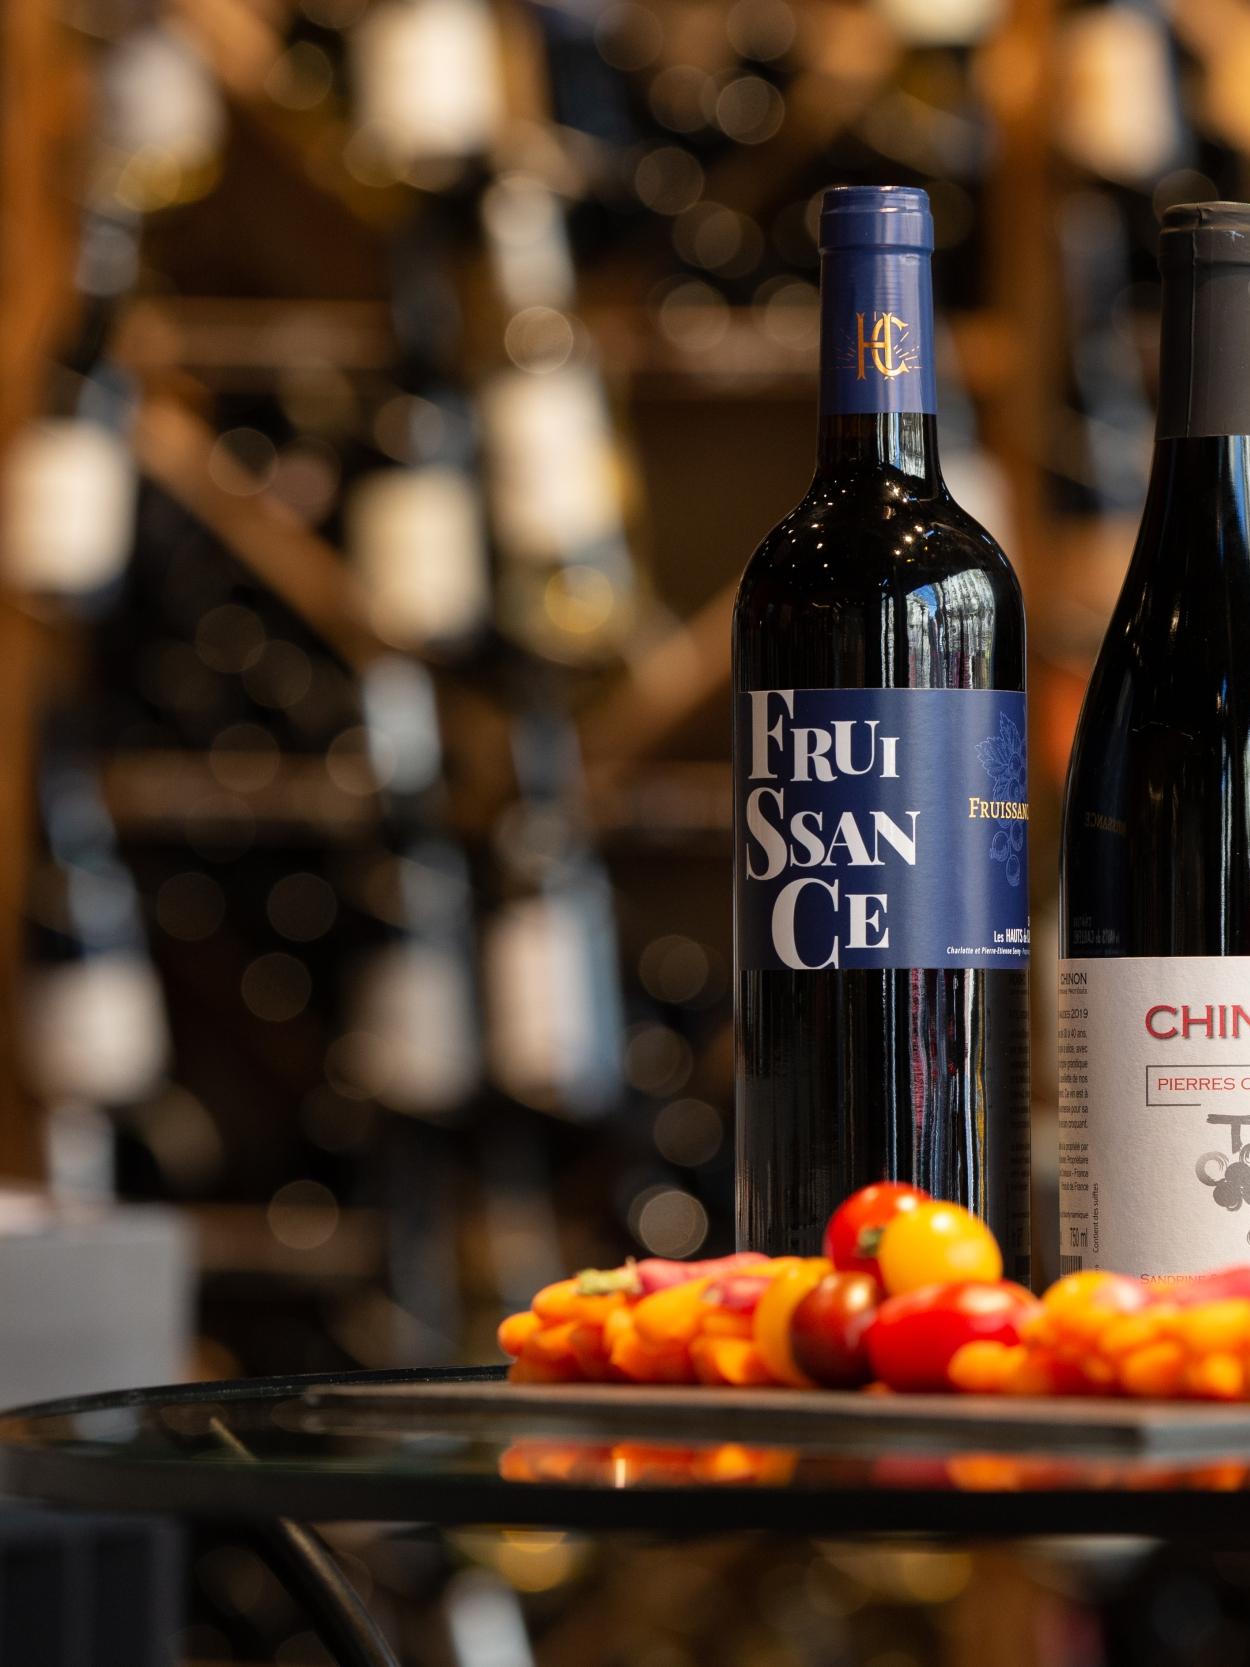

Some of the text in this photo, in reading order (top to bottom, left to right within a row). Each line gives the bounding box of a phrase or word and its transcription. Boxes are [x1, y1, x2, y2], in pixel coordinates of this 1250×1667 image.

[747, 690, 900, 782] FRUI
[746, 787, 921, 881] SSAN
[771, 878, 889, 970] CE
[993, 930, 1004, 943] Les
[1005, 928, 1023, 943] HAUTS
[946, 946, 973, 955] Charlotte
[974, 946, 981, 955] et
[1071, 1008, 1089, 1019] 2019
[1157, 1077, 1235, 1091] PIERRES
